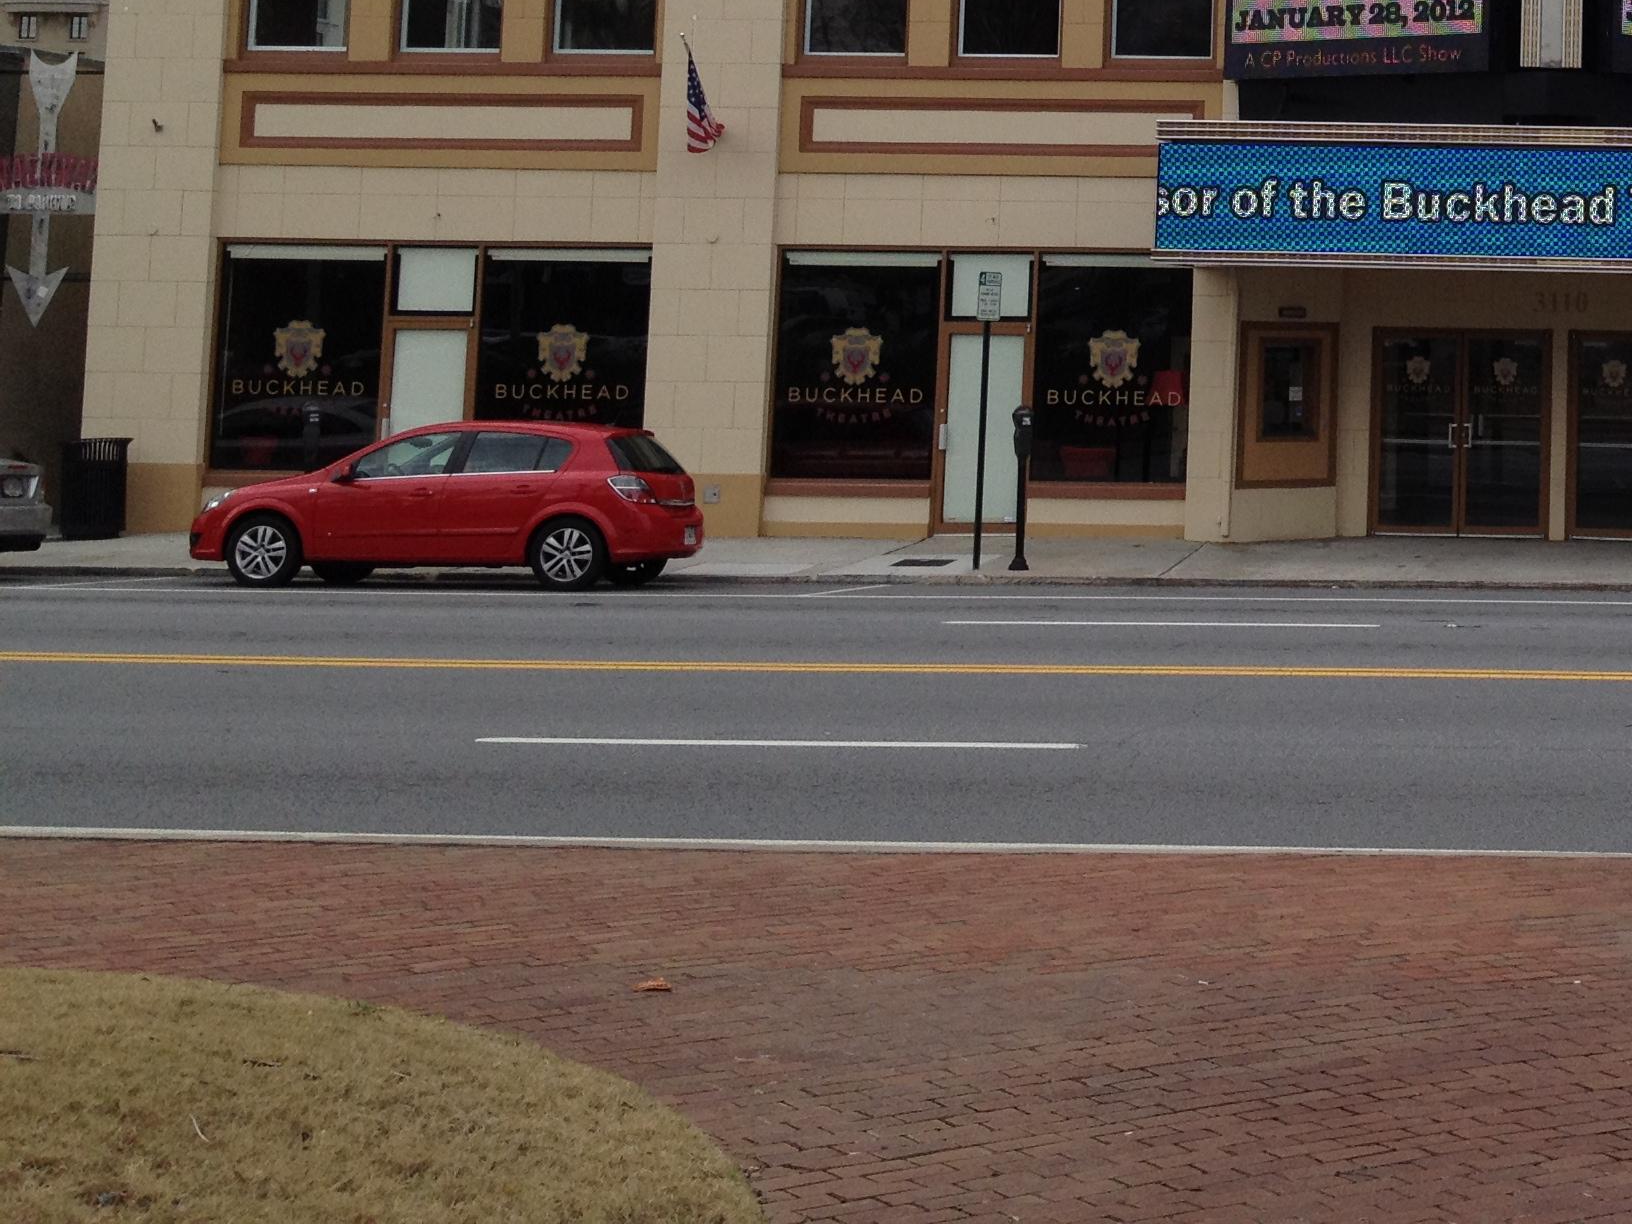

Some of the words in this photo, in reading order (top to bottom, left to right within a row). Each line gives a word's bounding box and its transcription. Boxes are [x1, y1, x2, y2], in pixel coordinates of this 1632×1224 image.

[1235, 3, 1364, 31] JANUARY
[1369, 2, 1408, 28] 28,
[1245, 52, 1255, 67] A
[1260, 51, 1281, 68] CP
[1286, 50, 1376, 66] Productions
[1383, 47, 1412, 64] LLC
[1419, 46, 1462, 62] Show
[1232, 177, 1278, 218] of
[1290, 180, 1366, 220] the
[1384, 182, 1614, 225] Buckhead
[232, 379, 365, 396] BUCKHEAD
[495, 384, 629, 400] BUCKHEAD
[787, 387, 924, 405] BUCKHEAD
[1046, 390, 1182, 407] BUCKHEAD
